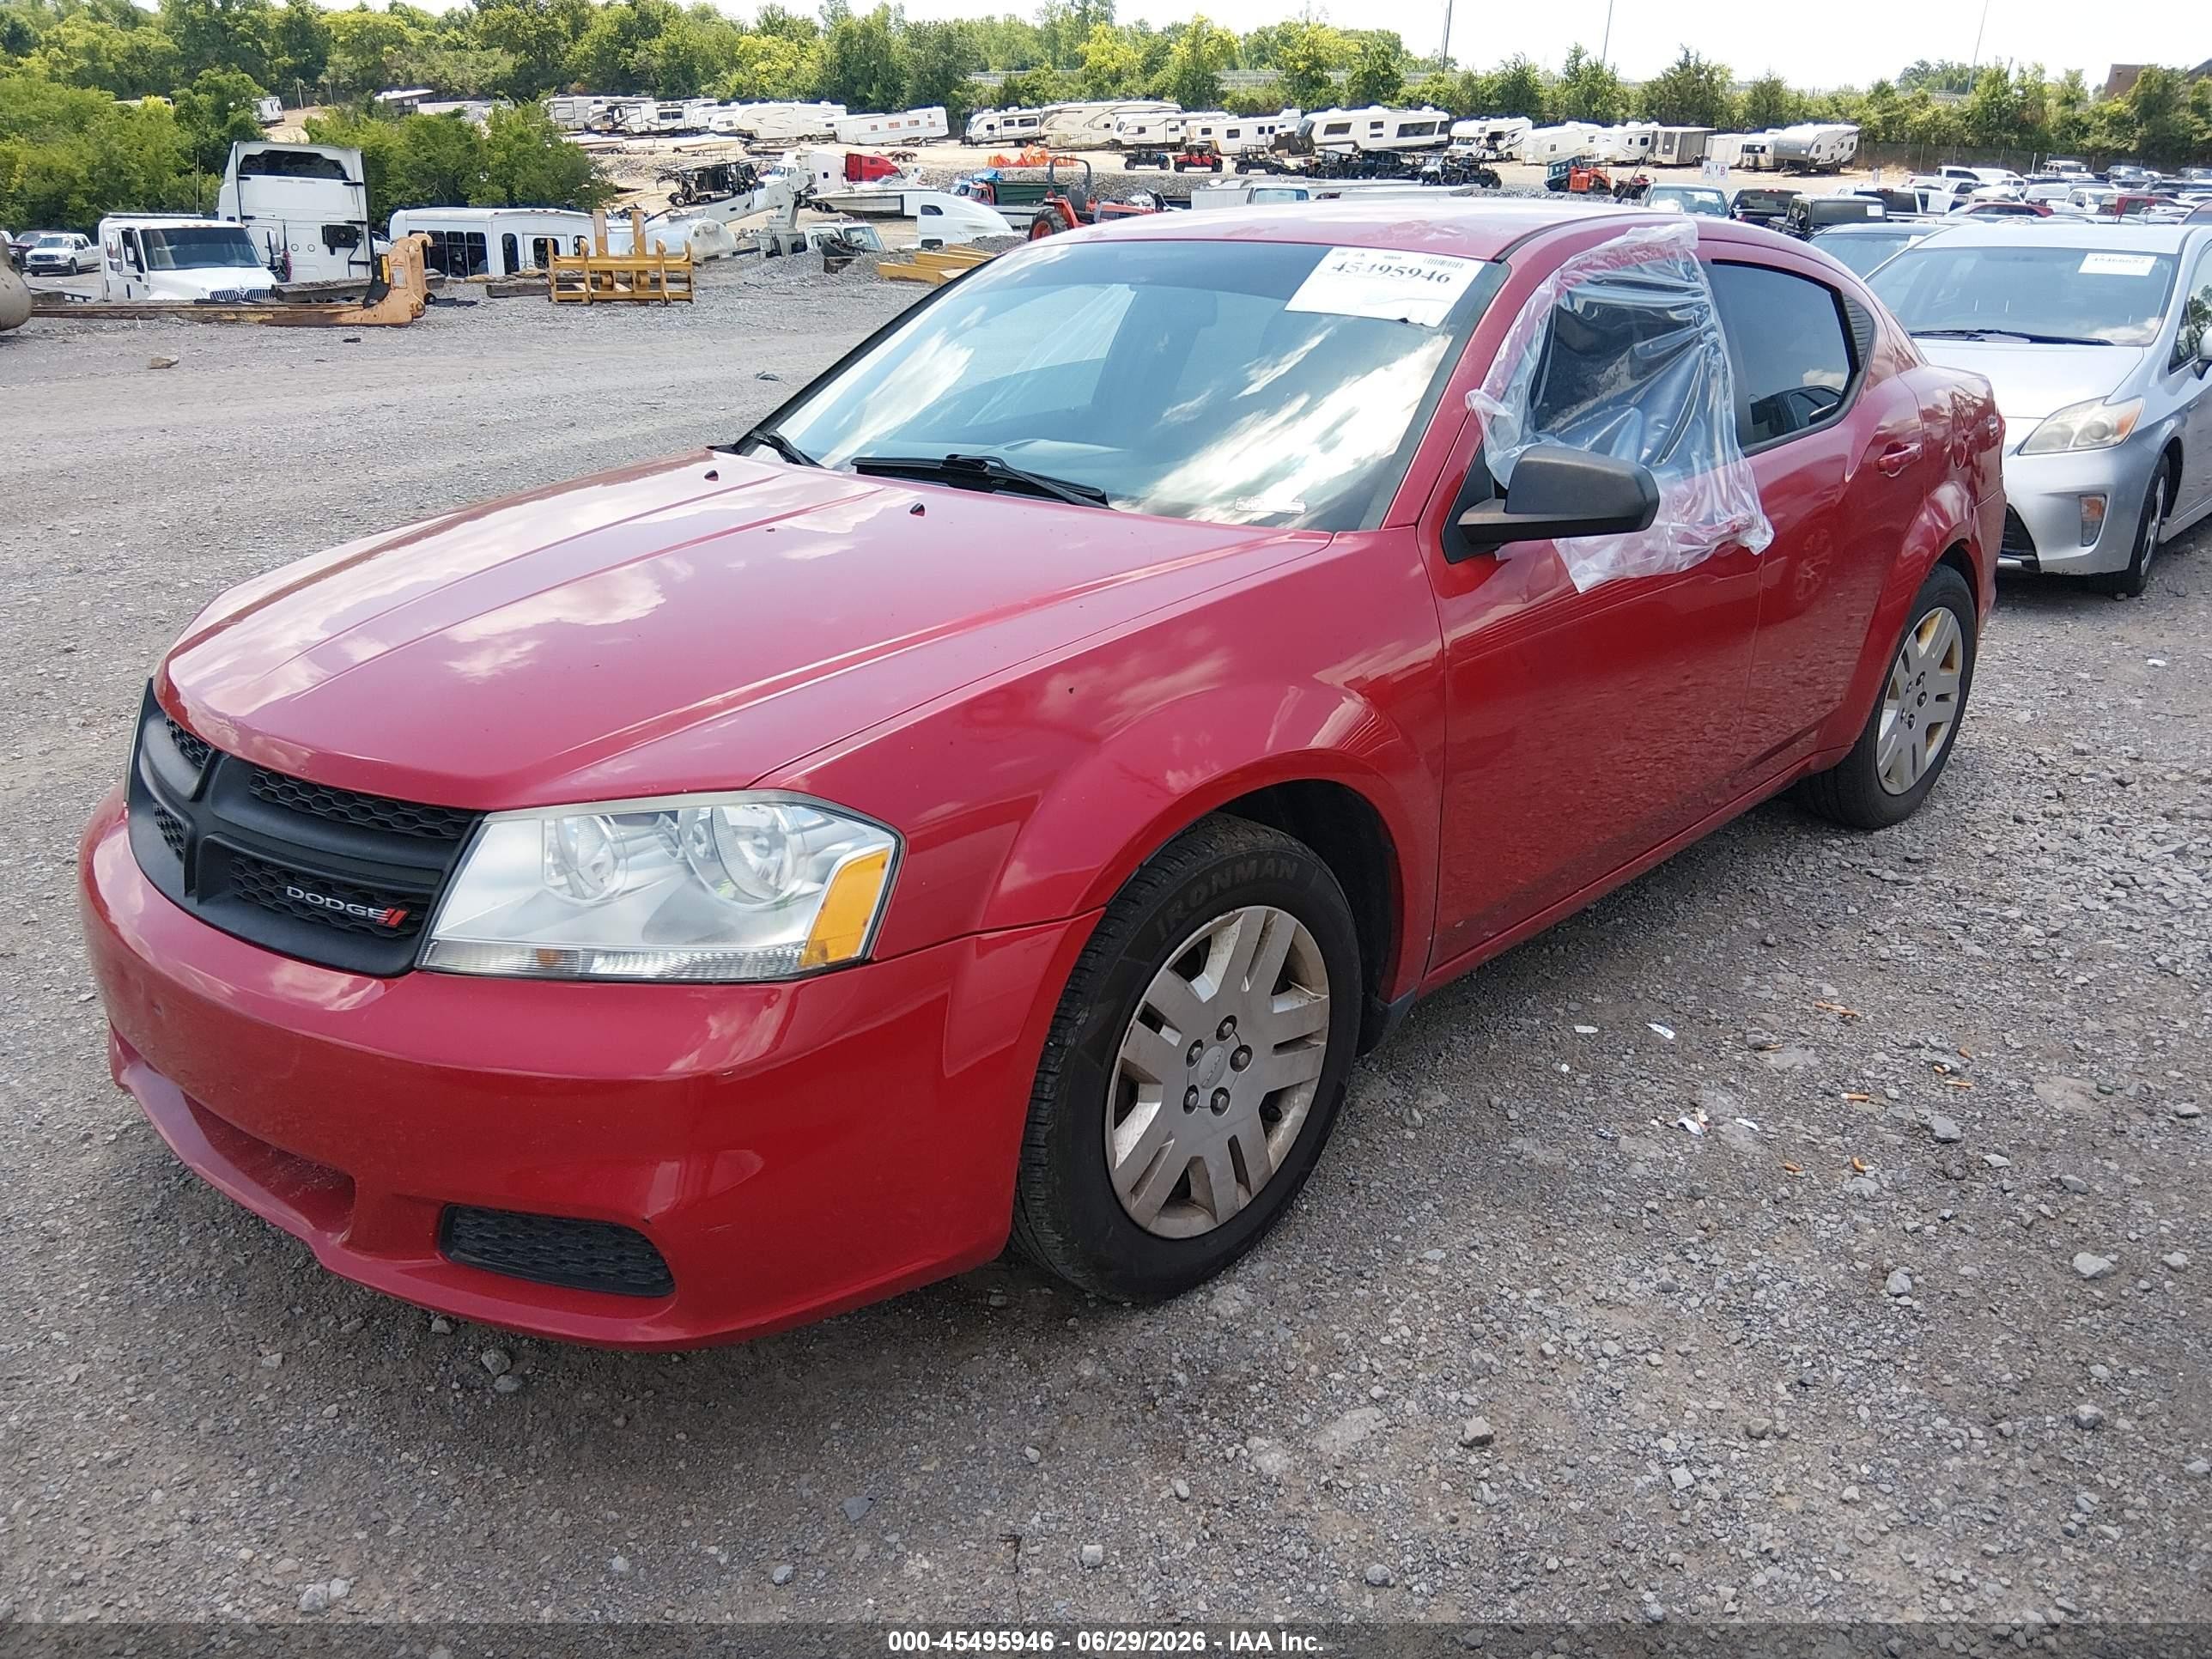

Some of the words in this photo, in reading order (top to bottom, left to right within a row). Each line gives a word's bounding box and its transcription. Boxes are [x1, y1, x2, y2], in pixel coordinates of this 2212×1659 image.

[1705, 166, 1711, 175] A
[1720, 167, 1726, 176] B
[286, 885, 389, 921] DODGE
[1158, 858, 1299, 941] IRONMAN
